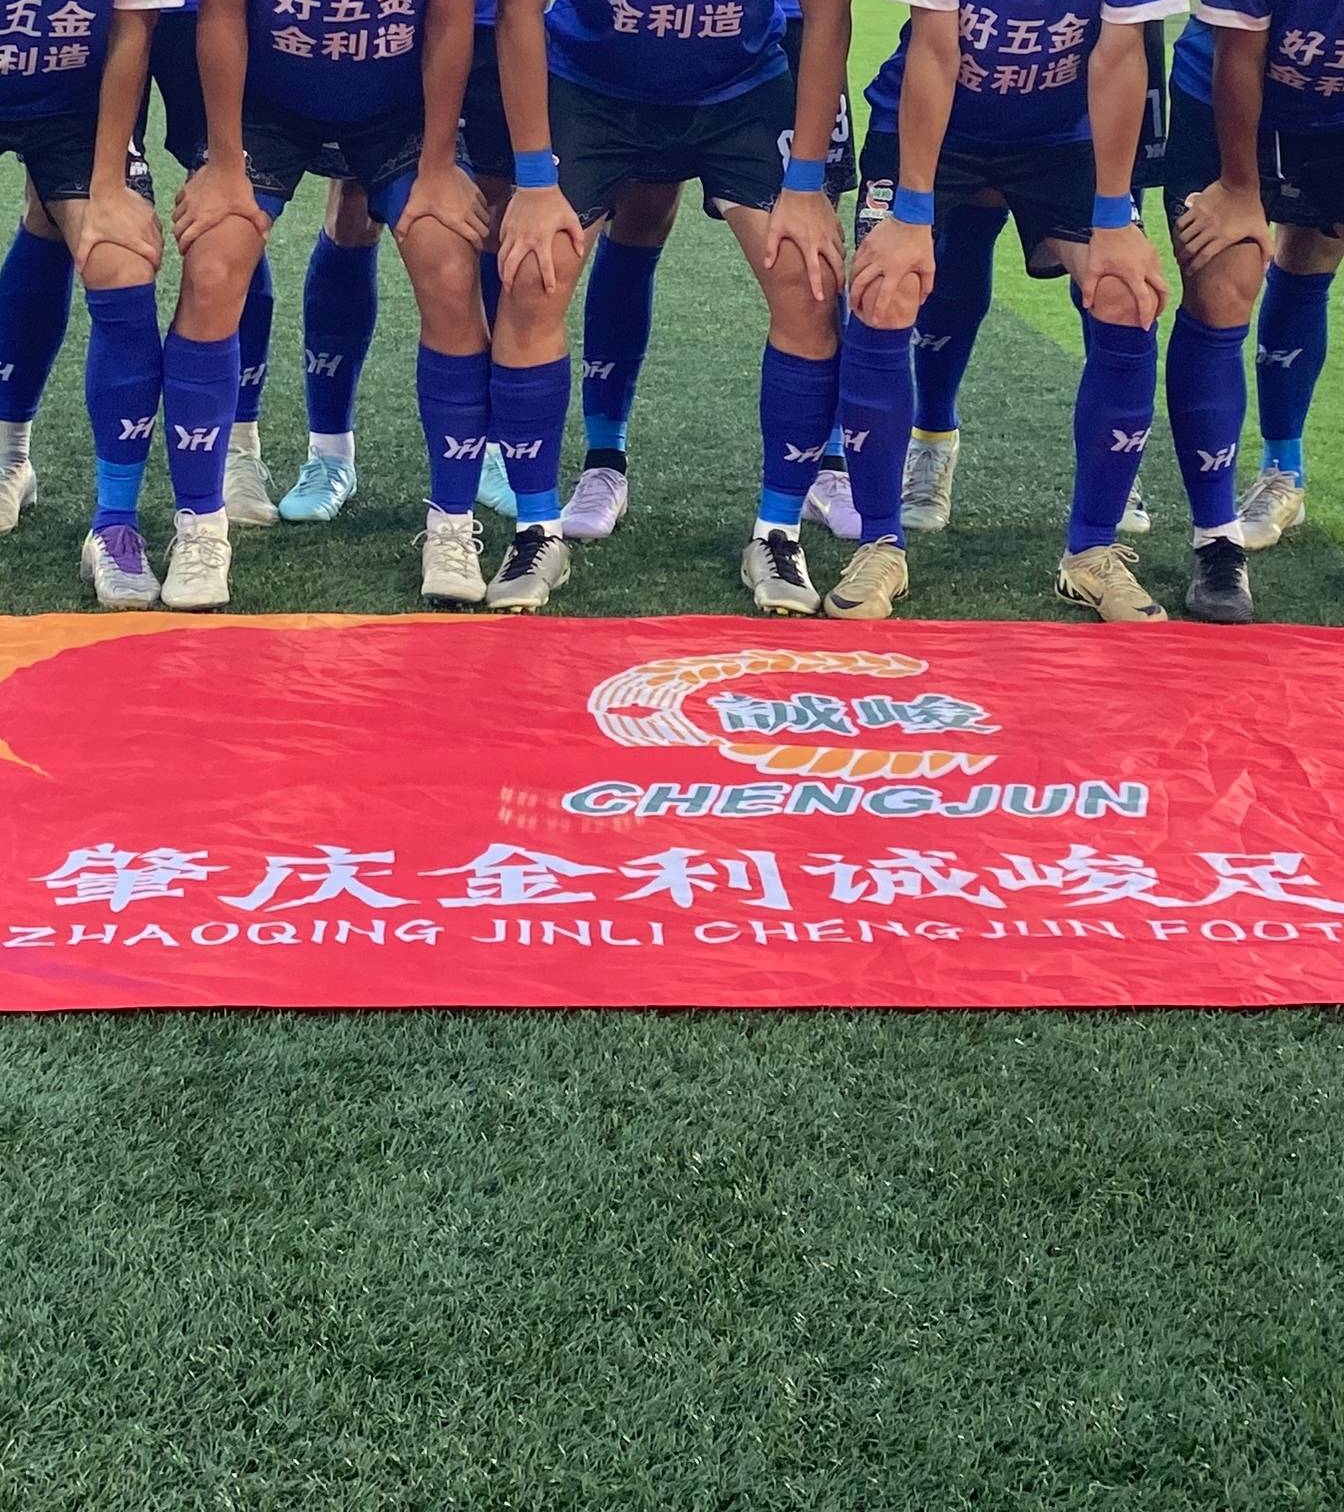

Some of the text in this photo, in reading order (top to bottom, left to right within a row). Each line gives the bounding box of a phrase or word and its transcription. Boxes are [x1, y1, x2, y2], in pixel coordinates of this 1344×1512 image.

[271, 22, 416, 62] 金利造
[960, 3, 1090, 56] 好五金
[959, 54, 1081, 95] 金利造
[562, 781, 1149, 819] CHENGJUN
[4, 918, 445, 949] ZHAOQING
[472, 918, 664, 948] JINLI
